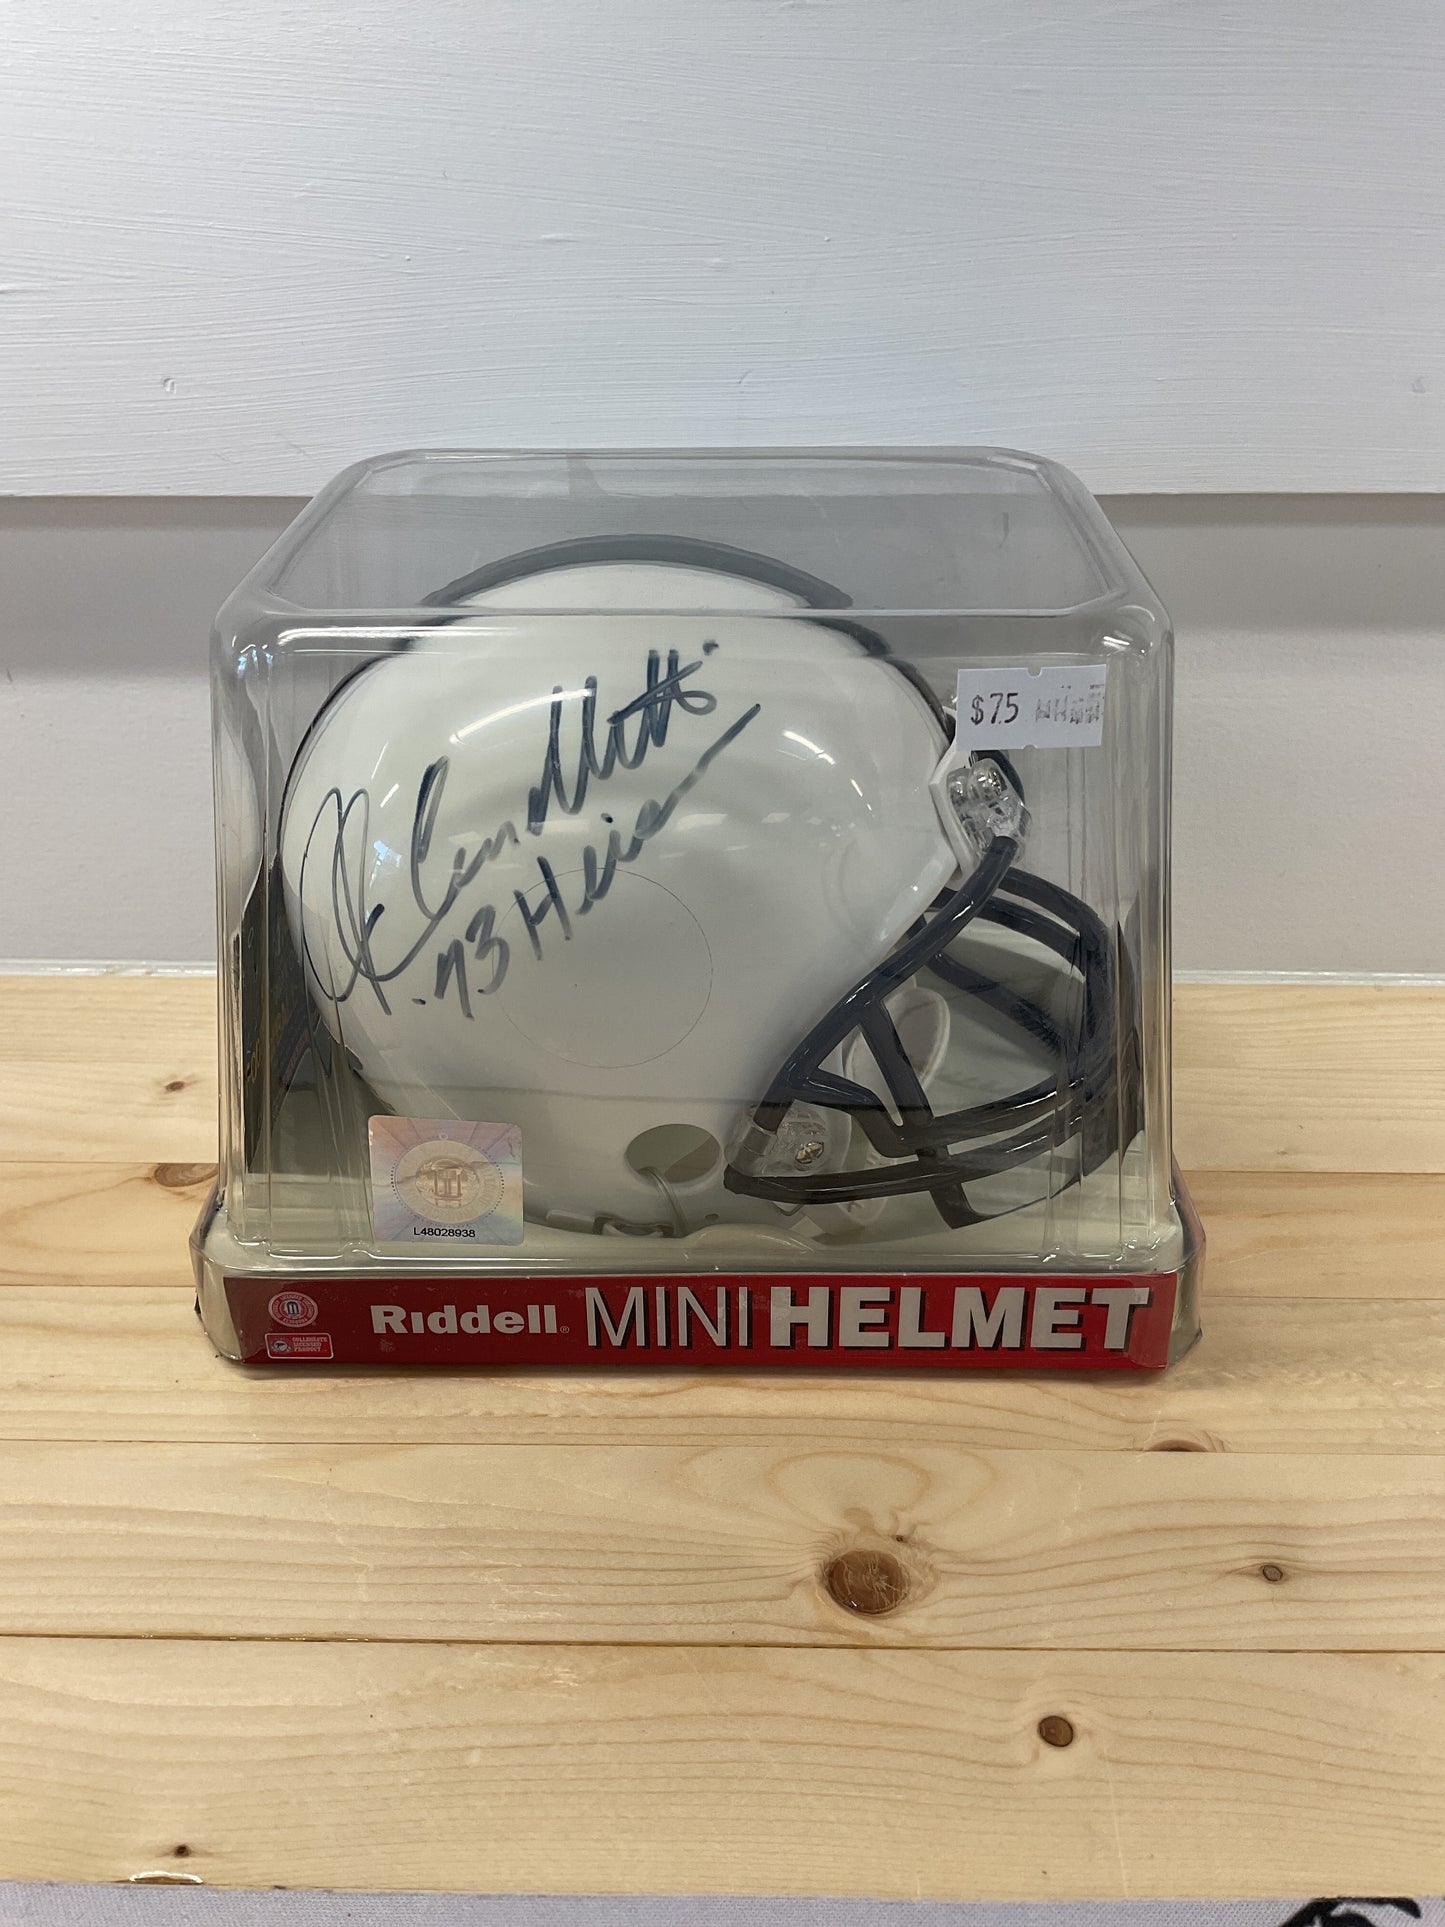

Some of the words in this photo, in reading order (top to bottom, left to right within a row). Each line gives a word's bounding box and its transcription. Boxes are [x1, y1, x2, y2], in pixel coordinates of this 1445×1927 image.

[970, 692, 1019, 725] $75
[413, 1226, 476, 1238] L48028938
[369, 1304, 558, 1335] Riddell
[584, 1285, 749, 1348] MINI
[769, 1285, 1151, 1350] HELMET
